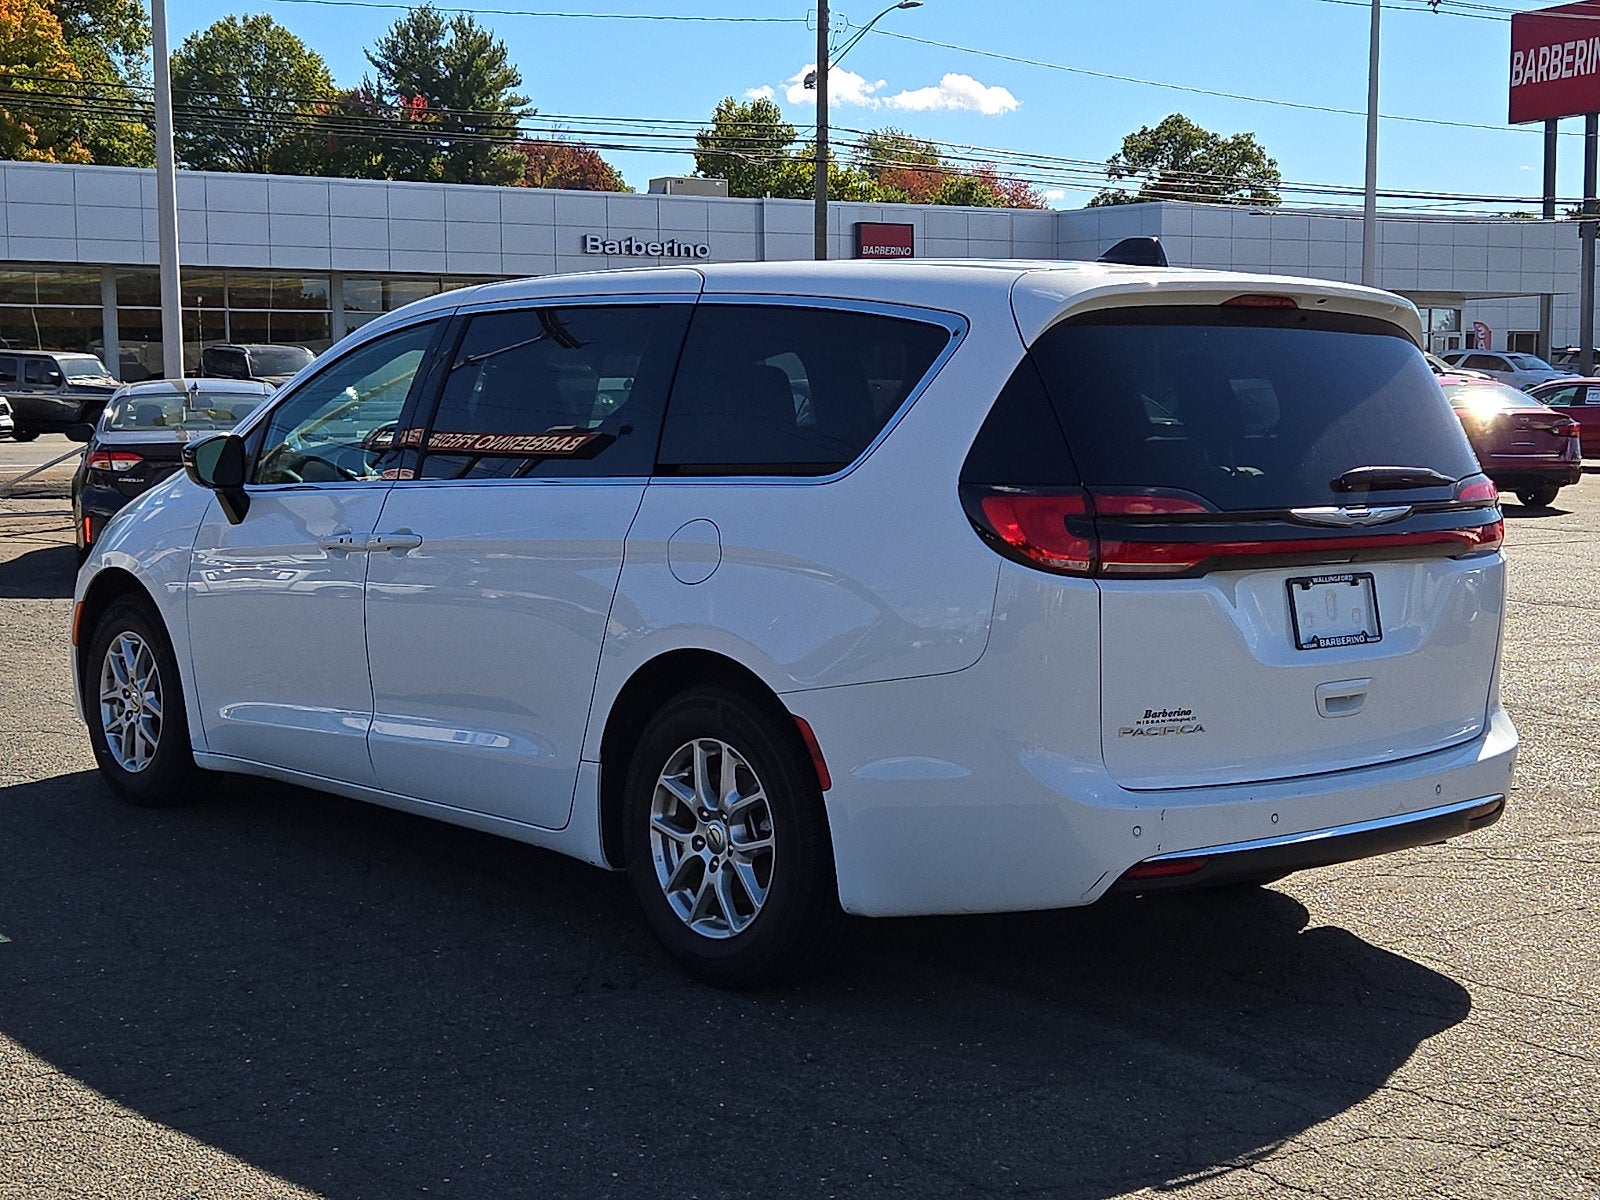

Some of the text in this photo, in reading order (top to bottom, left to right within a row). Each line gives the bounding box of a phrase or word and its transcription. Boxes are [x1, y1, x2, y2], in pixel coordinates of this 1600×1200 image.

[583, 234, 710, 258] Barberino
[862, 245, 911, 256] BARBERINO
[1320, 635, 1365, 647] BARBERINO
[1143, 708, 1192, 718] Barberino
[1118, 724, 1206, 738] PACIFICA
